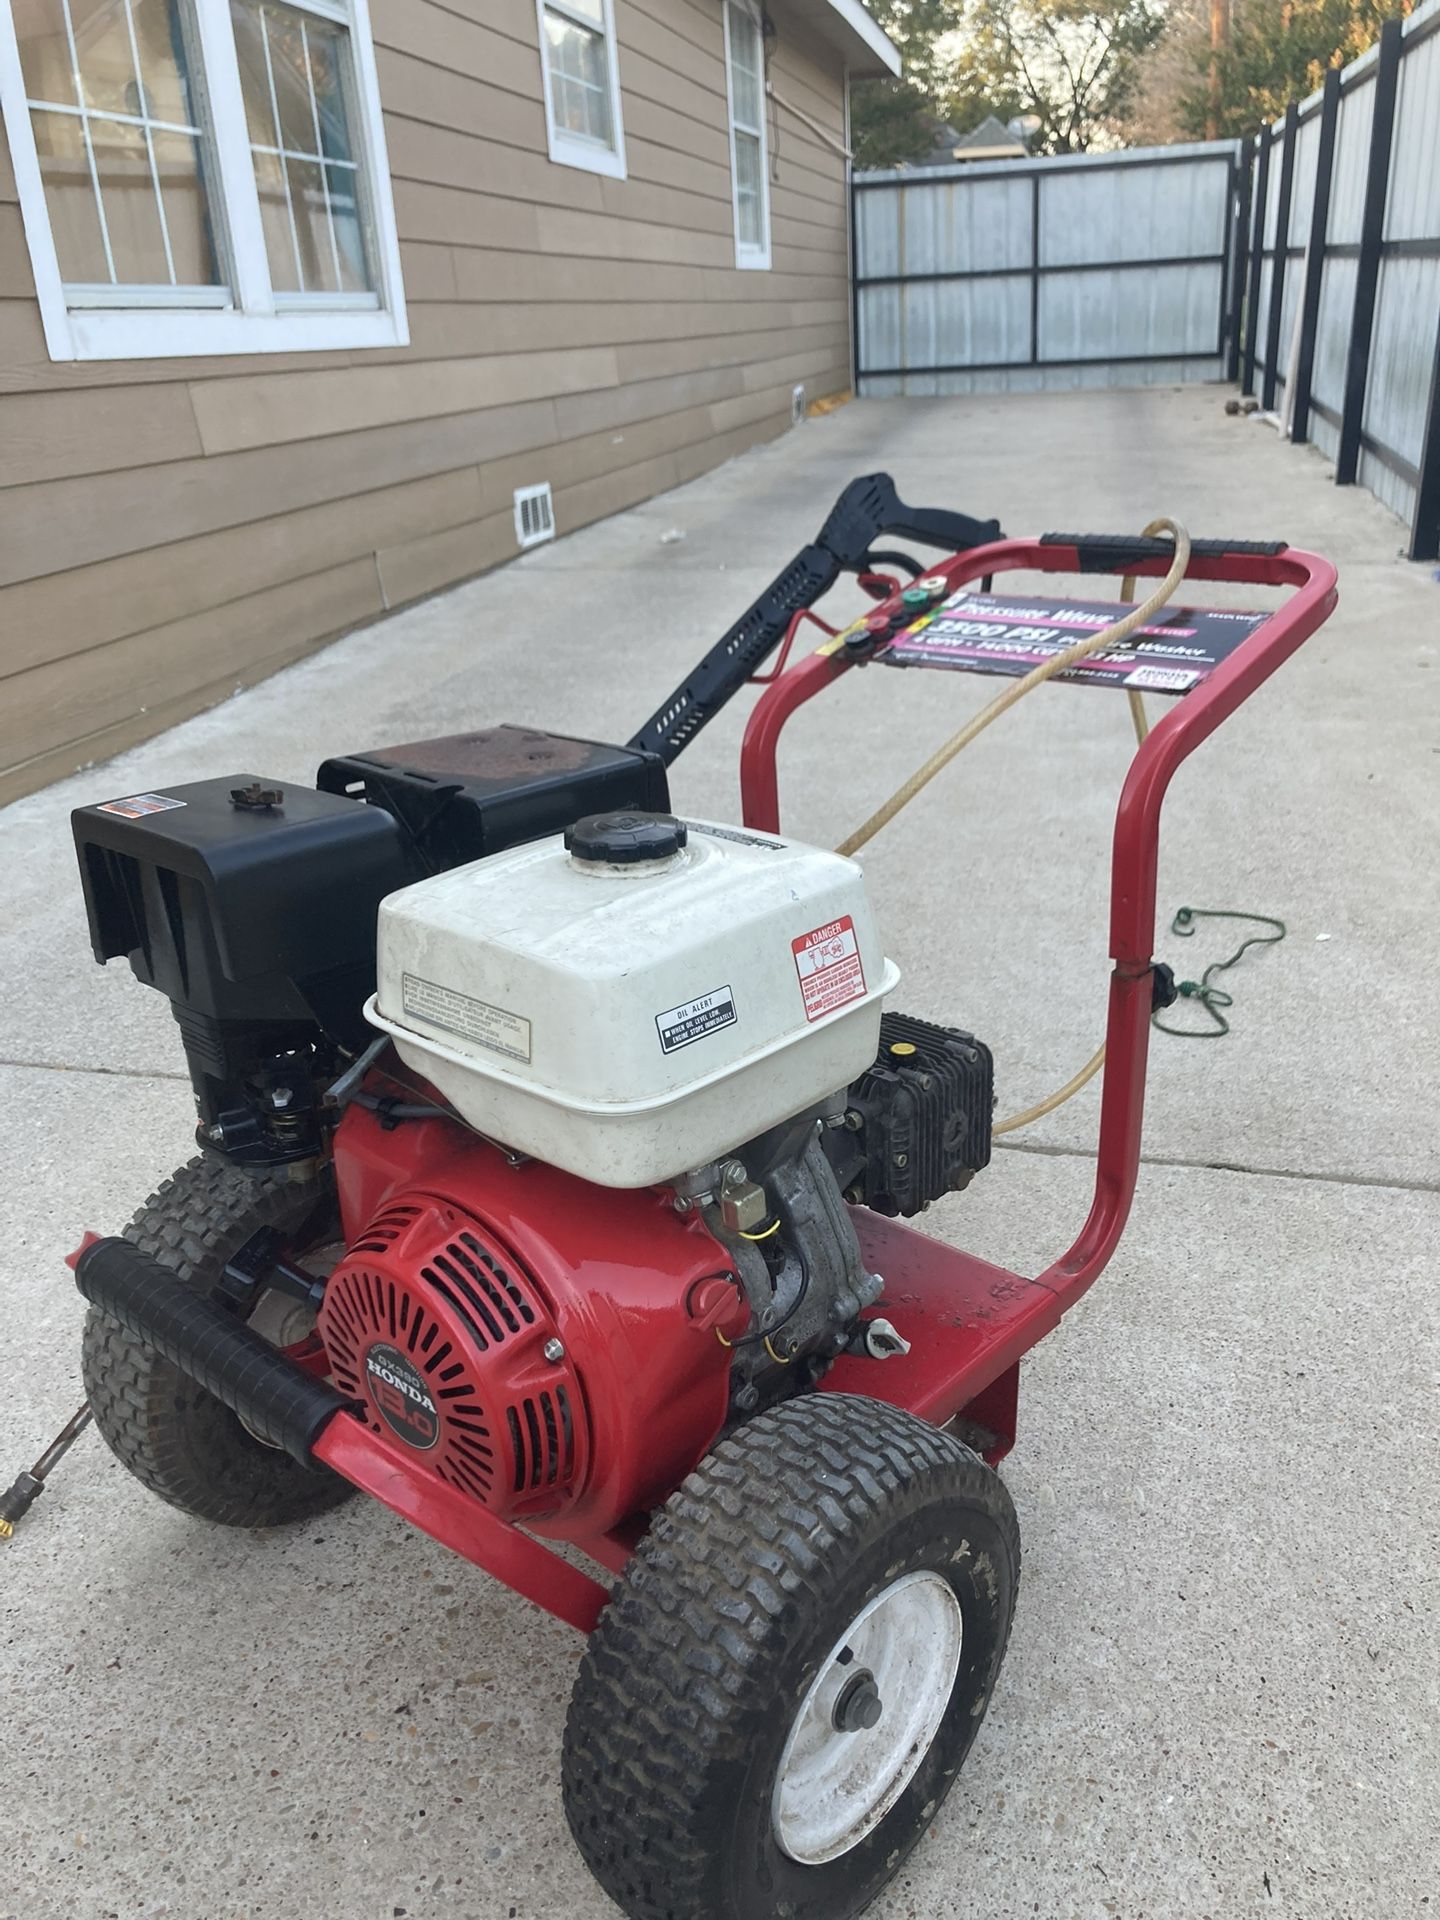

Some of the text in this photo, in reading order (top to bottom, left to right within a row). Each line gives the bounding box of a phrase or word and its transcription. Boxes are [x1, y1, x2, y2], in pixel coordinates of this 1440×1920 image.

[1049, 608, 1115, 625] WAVE
[927, 620, 1007, 637] 3500
[1004, 626, 1060, 642] PSI
[1136, 641, 1207, 656] Washer
[812, 923, 842, 945] DANGER
[677, 998, 713, 1020] OIL ALERT
[671, 1024, 686, 1036] WHEN
[695, 1014, 708, 1025] LEVEL
[673, 1031, 689, 1044] ENGINE
[690, 1024, 704, 1036] STOPS
[377, 1355, 421, 1388] GX390
[366, 1358, 437, 1414] HONDA
[371, 1375, 434, 1438] 13.0
